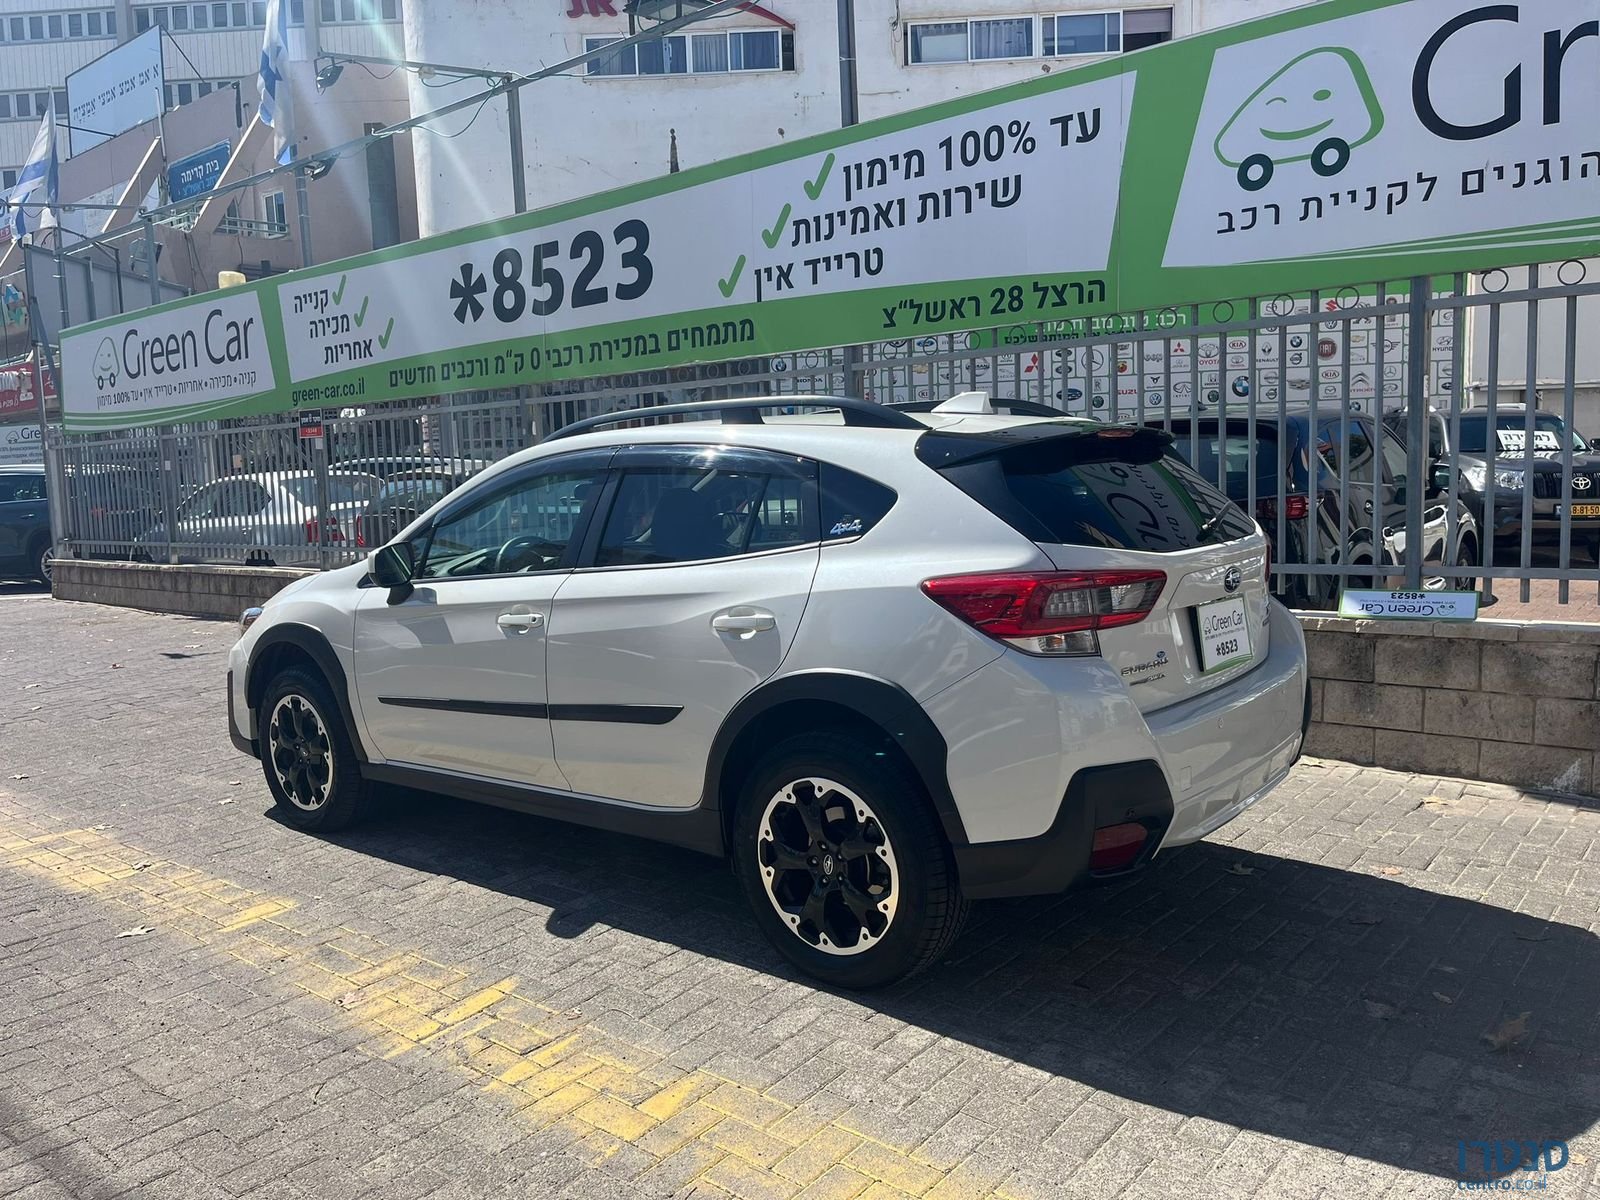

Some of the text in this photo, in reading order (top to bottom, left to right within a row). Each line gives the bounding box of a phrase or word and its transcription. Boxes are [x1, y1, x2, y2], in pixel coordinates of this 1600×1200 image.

[842, 107, 1101, 202] עד 100% מימון
[180, 159, 220, 184] בית קרימה
[1298, 171, 1438, 222] לקניית
[791, 174, 1023, 248] שירות ואמינות
[1216, 203, 1281, 235] רכב
[754, 246, 884, 302] טרייד אין
[293, 289, 329, 315] קנייה
[989, 285, 1024, 316] 28
[1032, 279, 1106, 310] הרצל
[309, 313, 351, 339] מכירה
[666, 318, 755, 351] מתמחים
[122, 308, 254, 380] Green Car
[324, 338, 374, 365] אחריות
[546, 344, 584, 369] רכבי
[588, 332, 660, 362] במכירת
[440, 356, 489, 382] ורכבים
[530, 346, 541, 371] 0
[178, 379, 204, 395] אחריות
[209, 375, 232, 389] מכירה
[238, 371, 257, 388] קניה
[389, 363, 437, 388] חדשים
[113, 391, 130, 405] 100%
[154, 383, 173, 397] טרייד
[292, 376, 366, 407] green-car.co.il
[1211, 610, 1243, 632] Green Car
[1359, 602, 1434, 616] Green Car
